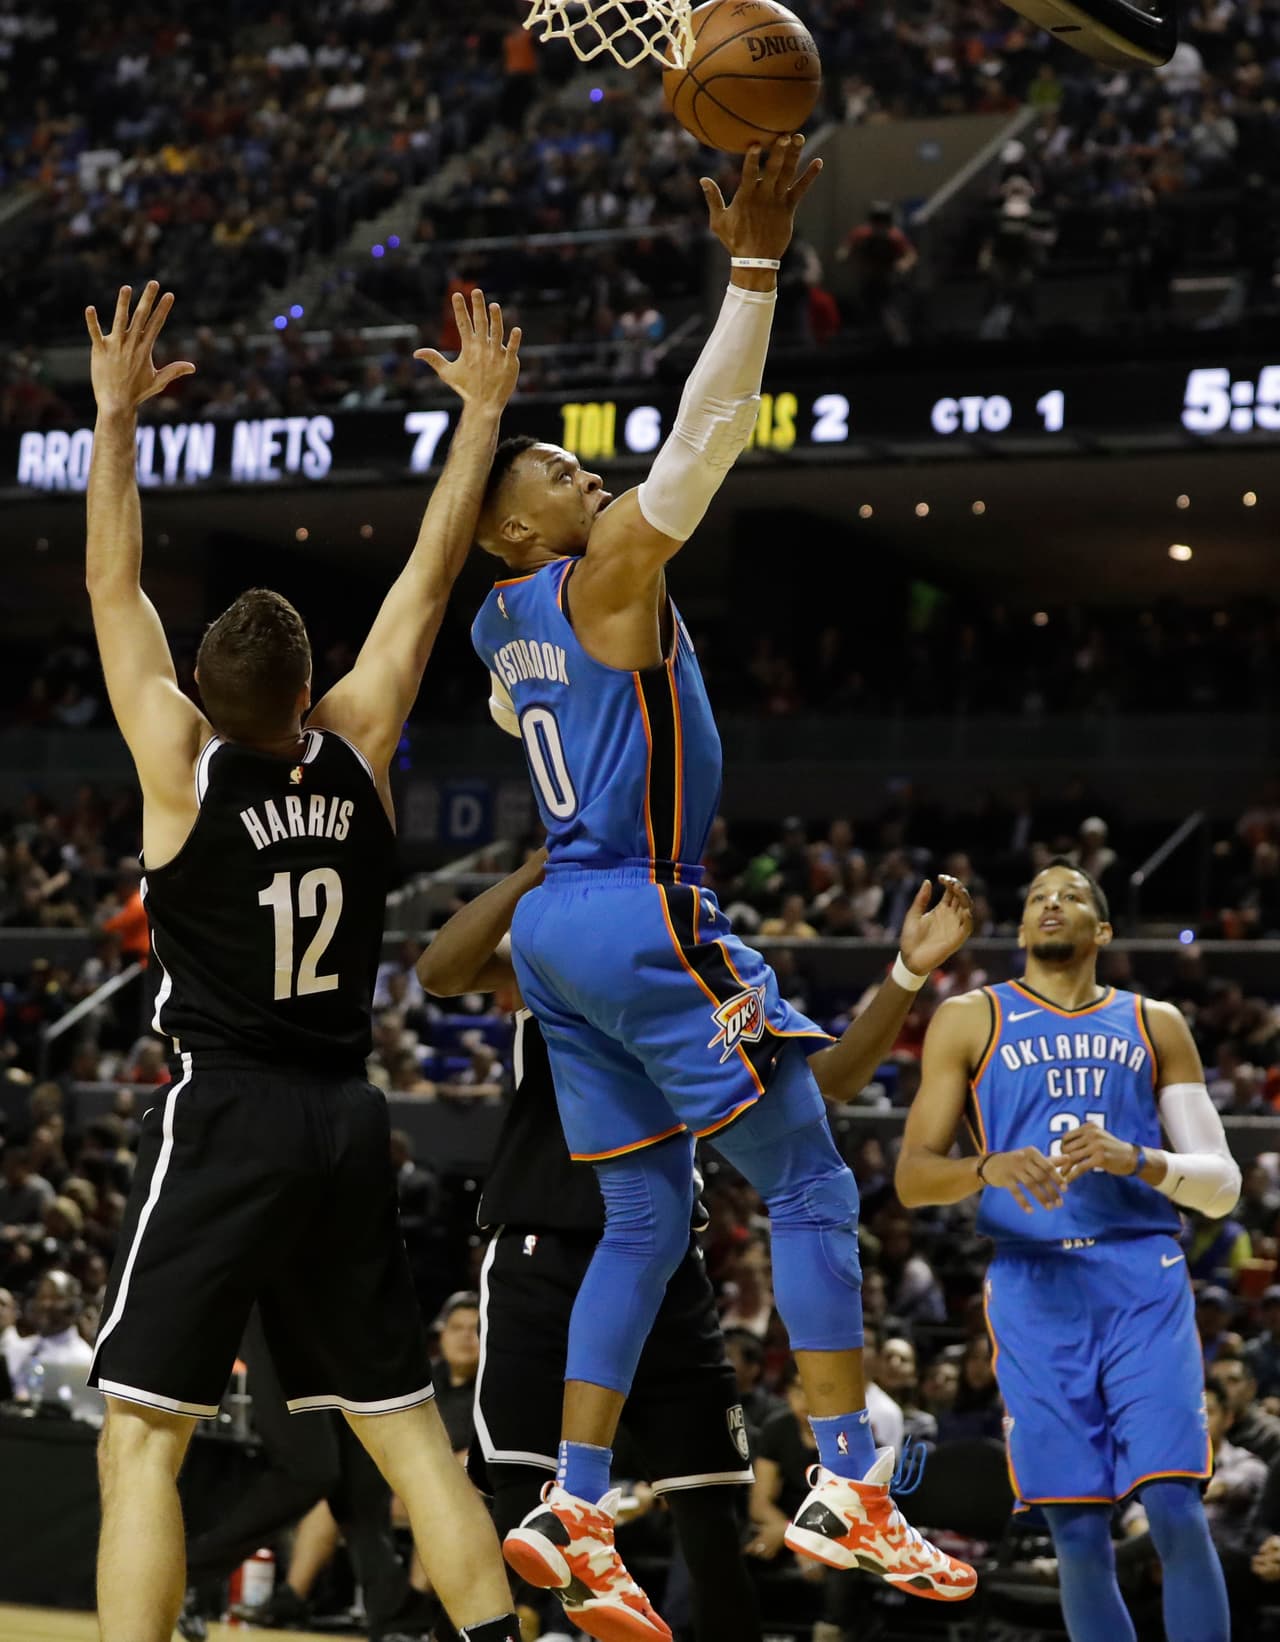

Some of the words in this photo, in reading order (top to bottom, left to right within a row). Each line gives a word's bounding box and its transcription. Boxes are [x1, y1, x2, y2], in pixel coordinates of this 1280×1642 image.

[18, 423, 215, 490] BROLYN
[231, 416, 333, 482] NETS
[404, 411, 449, 473] 7
[624, 406, 661, 452] 6
[811, 394, 849, 442] 2
[931, 395, 1012, 434] CTO
[1037, 390, 1064, 432] 1
[494, 640, 569, 692] STBROOK
[520, 704, 578, 822] 0
[240, 795, 354, 850] HARRIS
[258, 867, 343, 1000] 12
[727, 998, 756, 1044] OKC
[1000, 1033, 1146, 1073] OKLAHOMA
[1047, 1067, 1105, 1097] CITY
